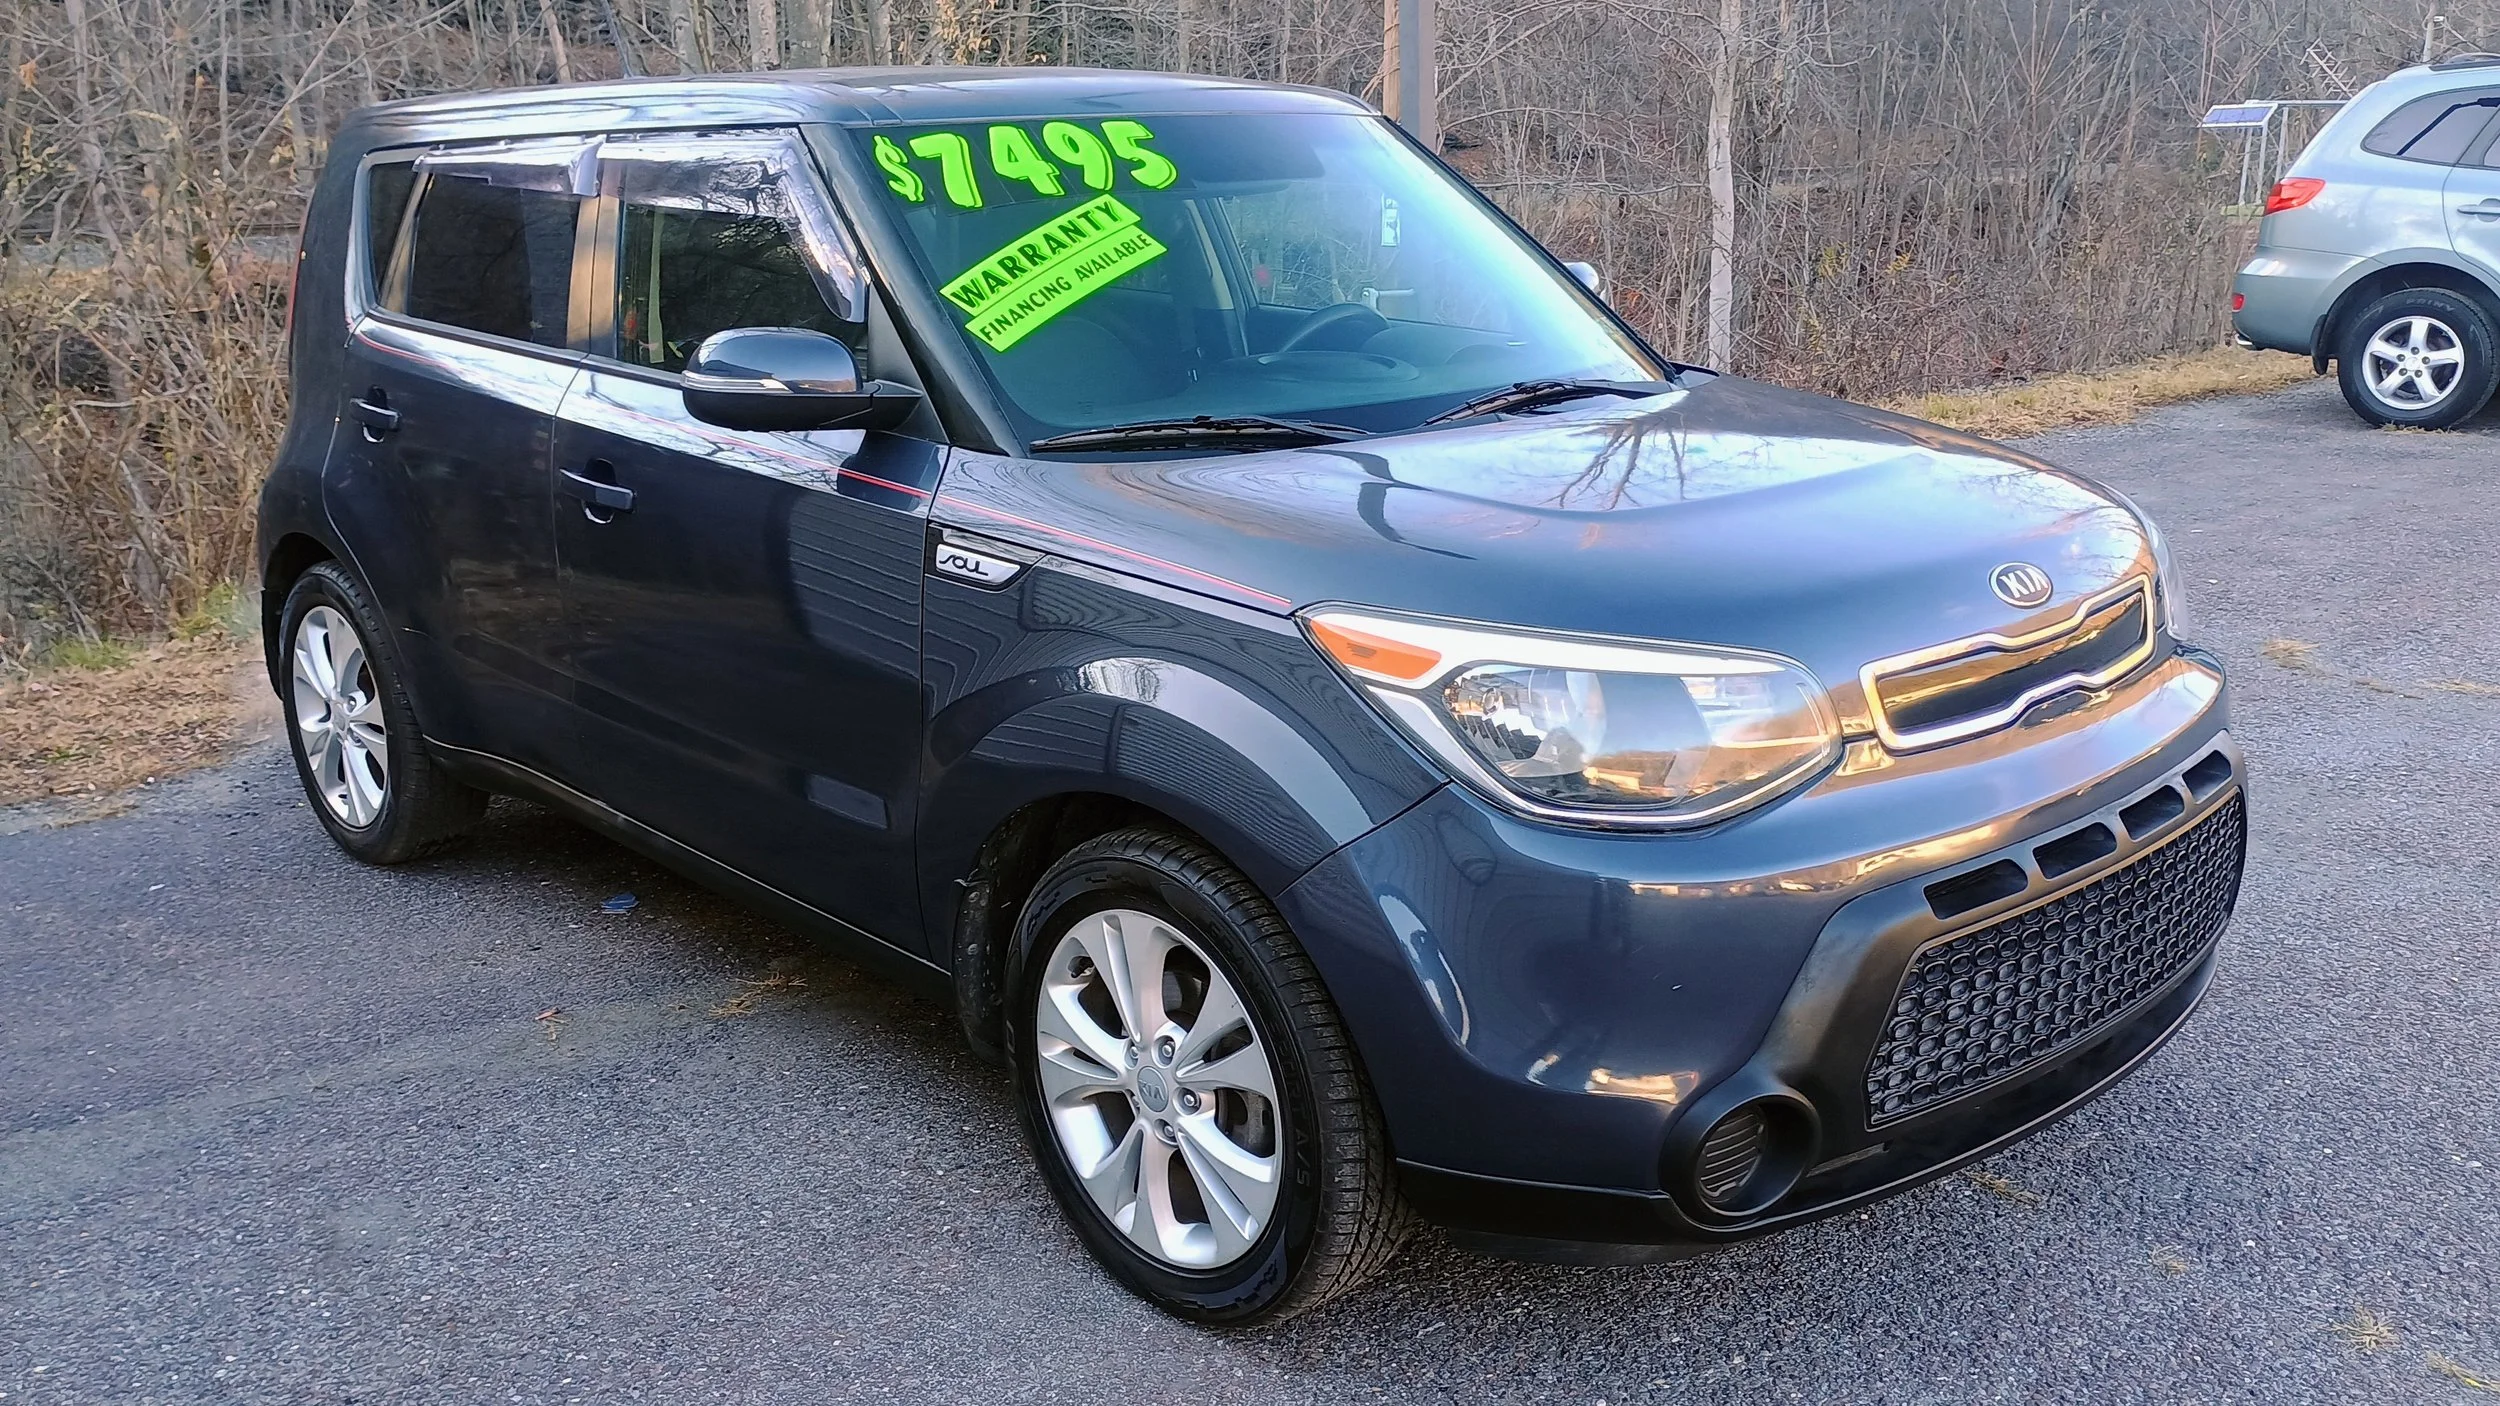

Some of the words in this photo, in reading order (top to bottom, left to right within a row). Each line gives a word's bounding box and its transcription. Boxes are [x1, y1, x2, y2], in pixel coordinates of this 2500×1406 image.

[873, 120, 1178, 208] $7495
[950, 200, 1121, 309] WARRANTY
[979, 276, 1072, 341] FINANCING
[1074, 233, 1151, 282] AVAILABLE
[938, 554, 989, 577] SOUL
[1999, 567, 2049, 599] KIA
[1137, 1079, 1166, 1101] KIA
